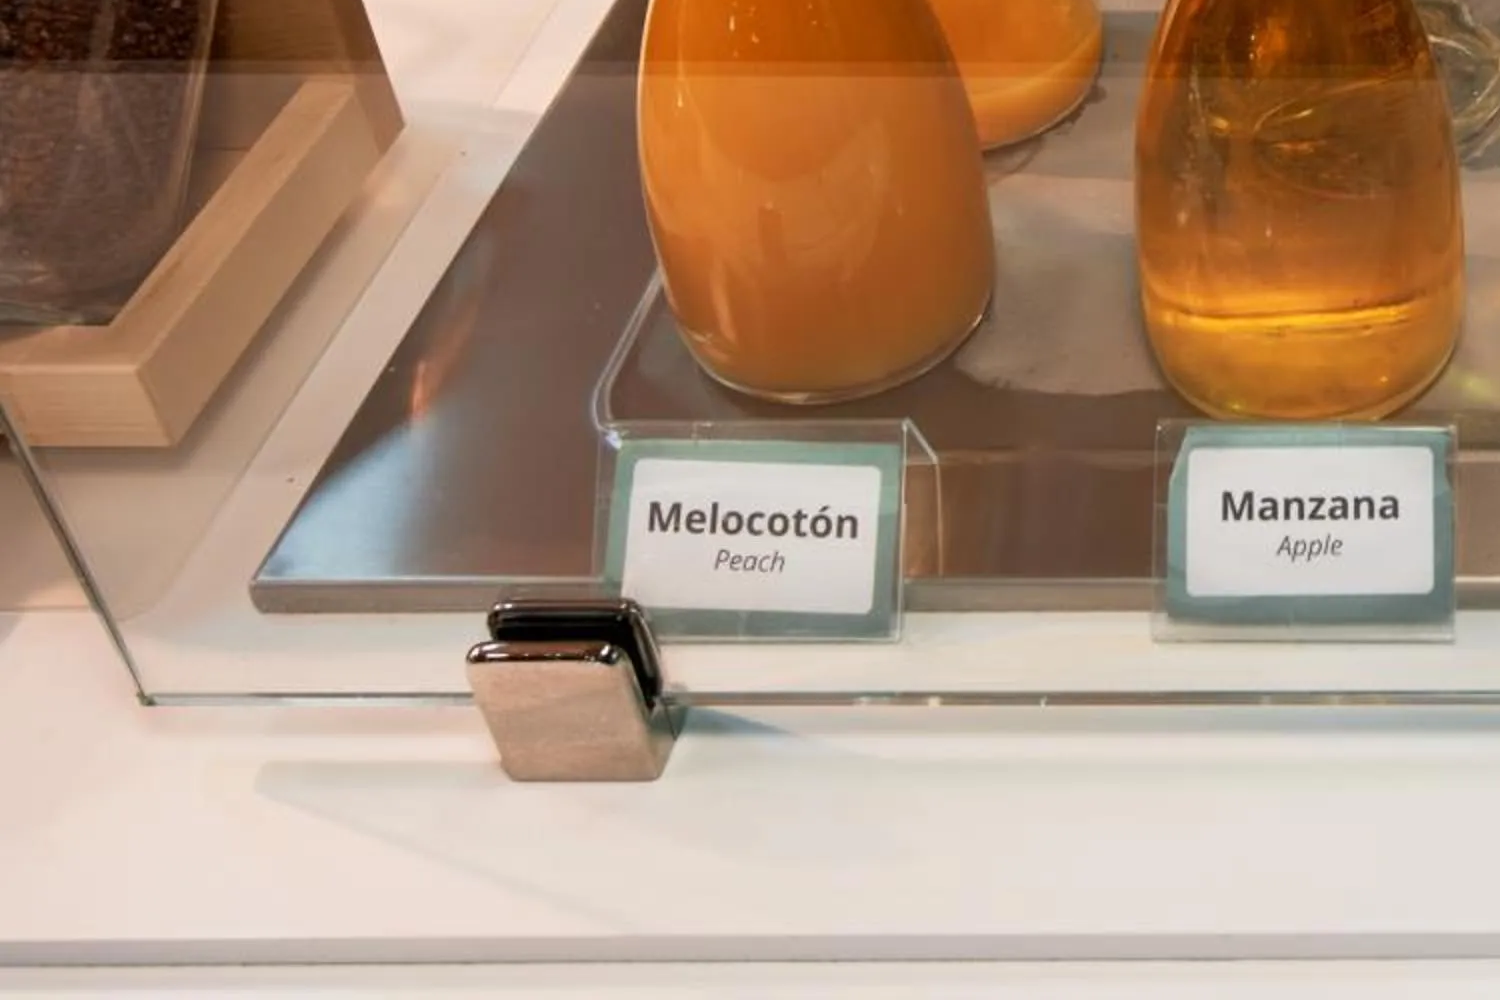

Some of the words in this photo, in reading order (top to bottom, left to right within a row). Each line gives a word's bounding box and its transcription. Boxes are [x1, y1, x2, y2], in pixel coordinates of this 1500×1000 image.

[647, 501, 858, 539] Melocotón
[1220, 490, 1400, 522] Manzana
[713, 548, 786, 573] Peach
[1275, 533, 1344, 563] Apple
